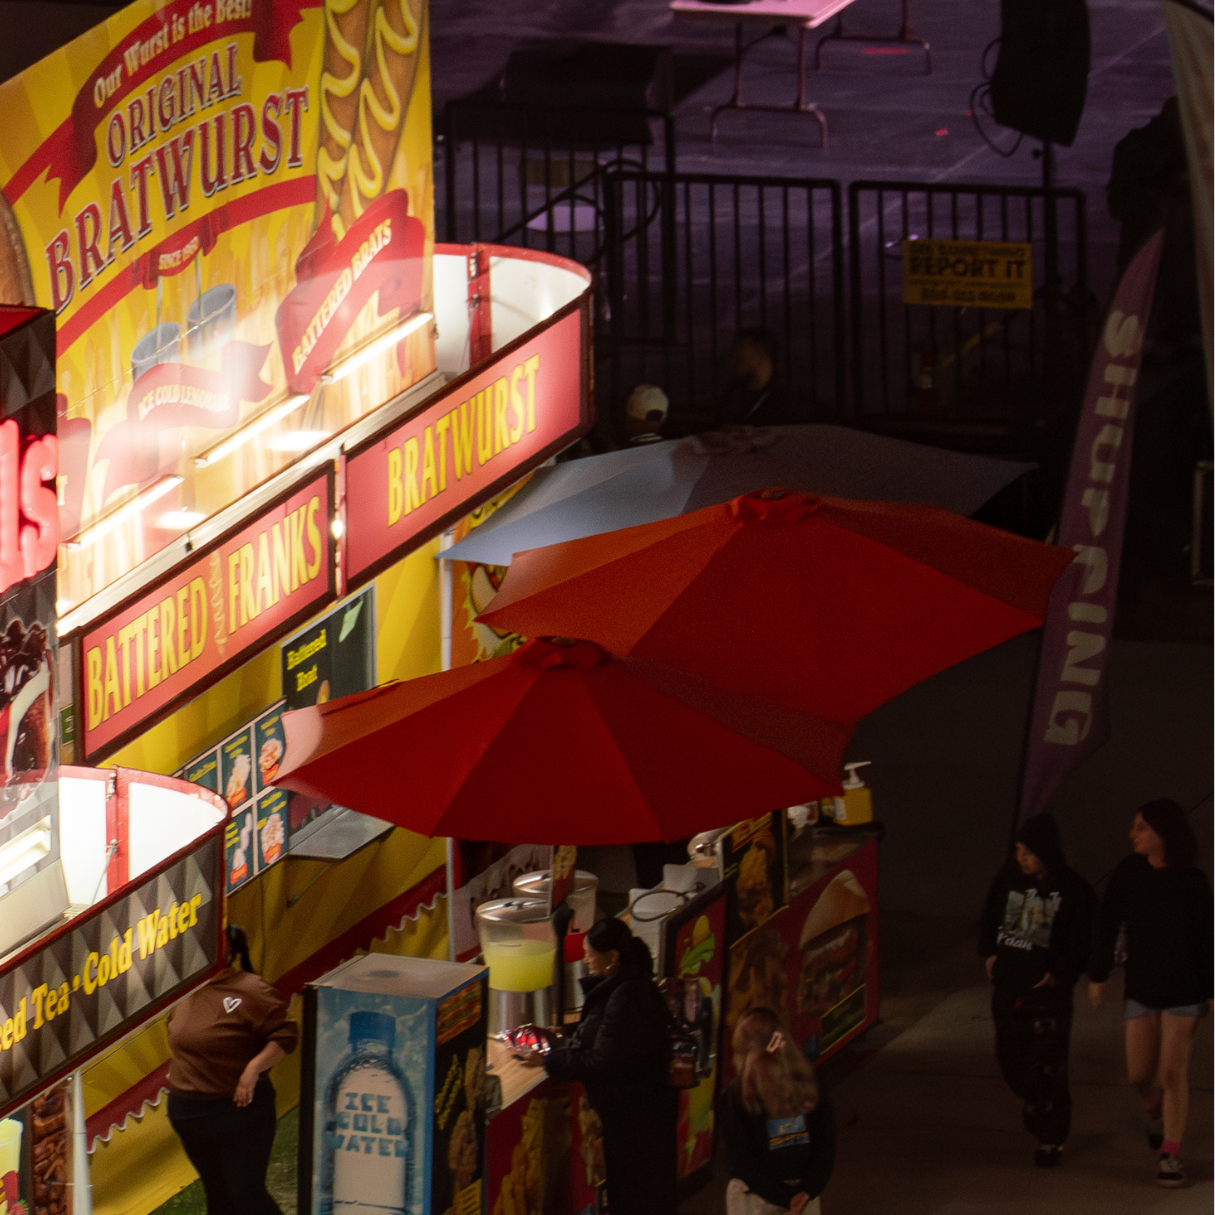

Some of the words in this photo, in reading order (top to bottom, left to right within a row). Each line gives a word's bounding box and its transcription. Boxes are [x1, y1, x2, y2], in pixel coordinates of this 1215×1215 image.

[93, 64, 123, 109] Our
[123, 21, 170, 77] Wurst
[171, 12, 185, 44] is
[187, 1, 213, 36] the
[106, 41, 243, 168] ORIGINAL
[44, 84, 310, 316] BRATWURST
[387, 354, 540, 529] BRATWURST
[85, 575, 209, 733] BATTERED
[227, 495, 323, 636] FRANKS
[31, 982, 70, 1031] Tea
[83, 928, 133, 996] Cold
[137, 893, 203, 961] Water
[336, 1112, 403, 1136] COLD
[344, 1092, 392, 1114] ICE
